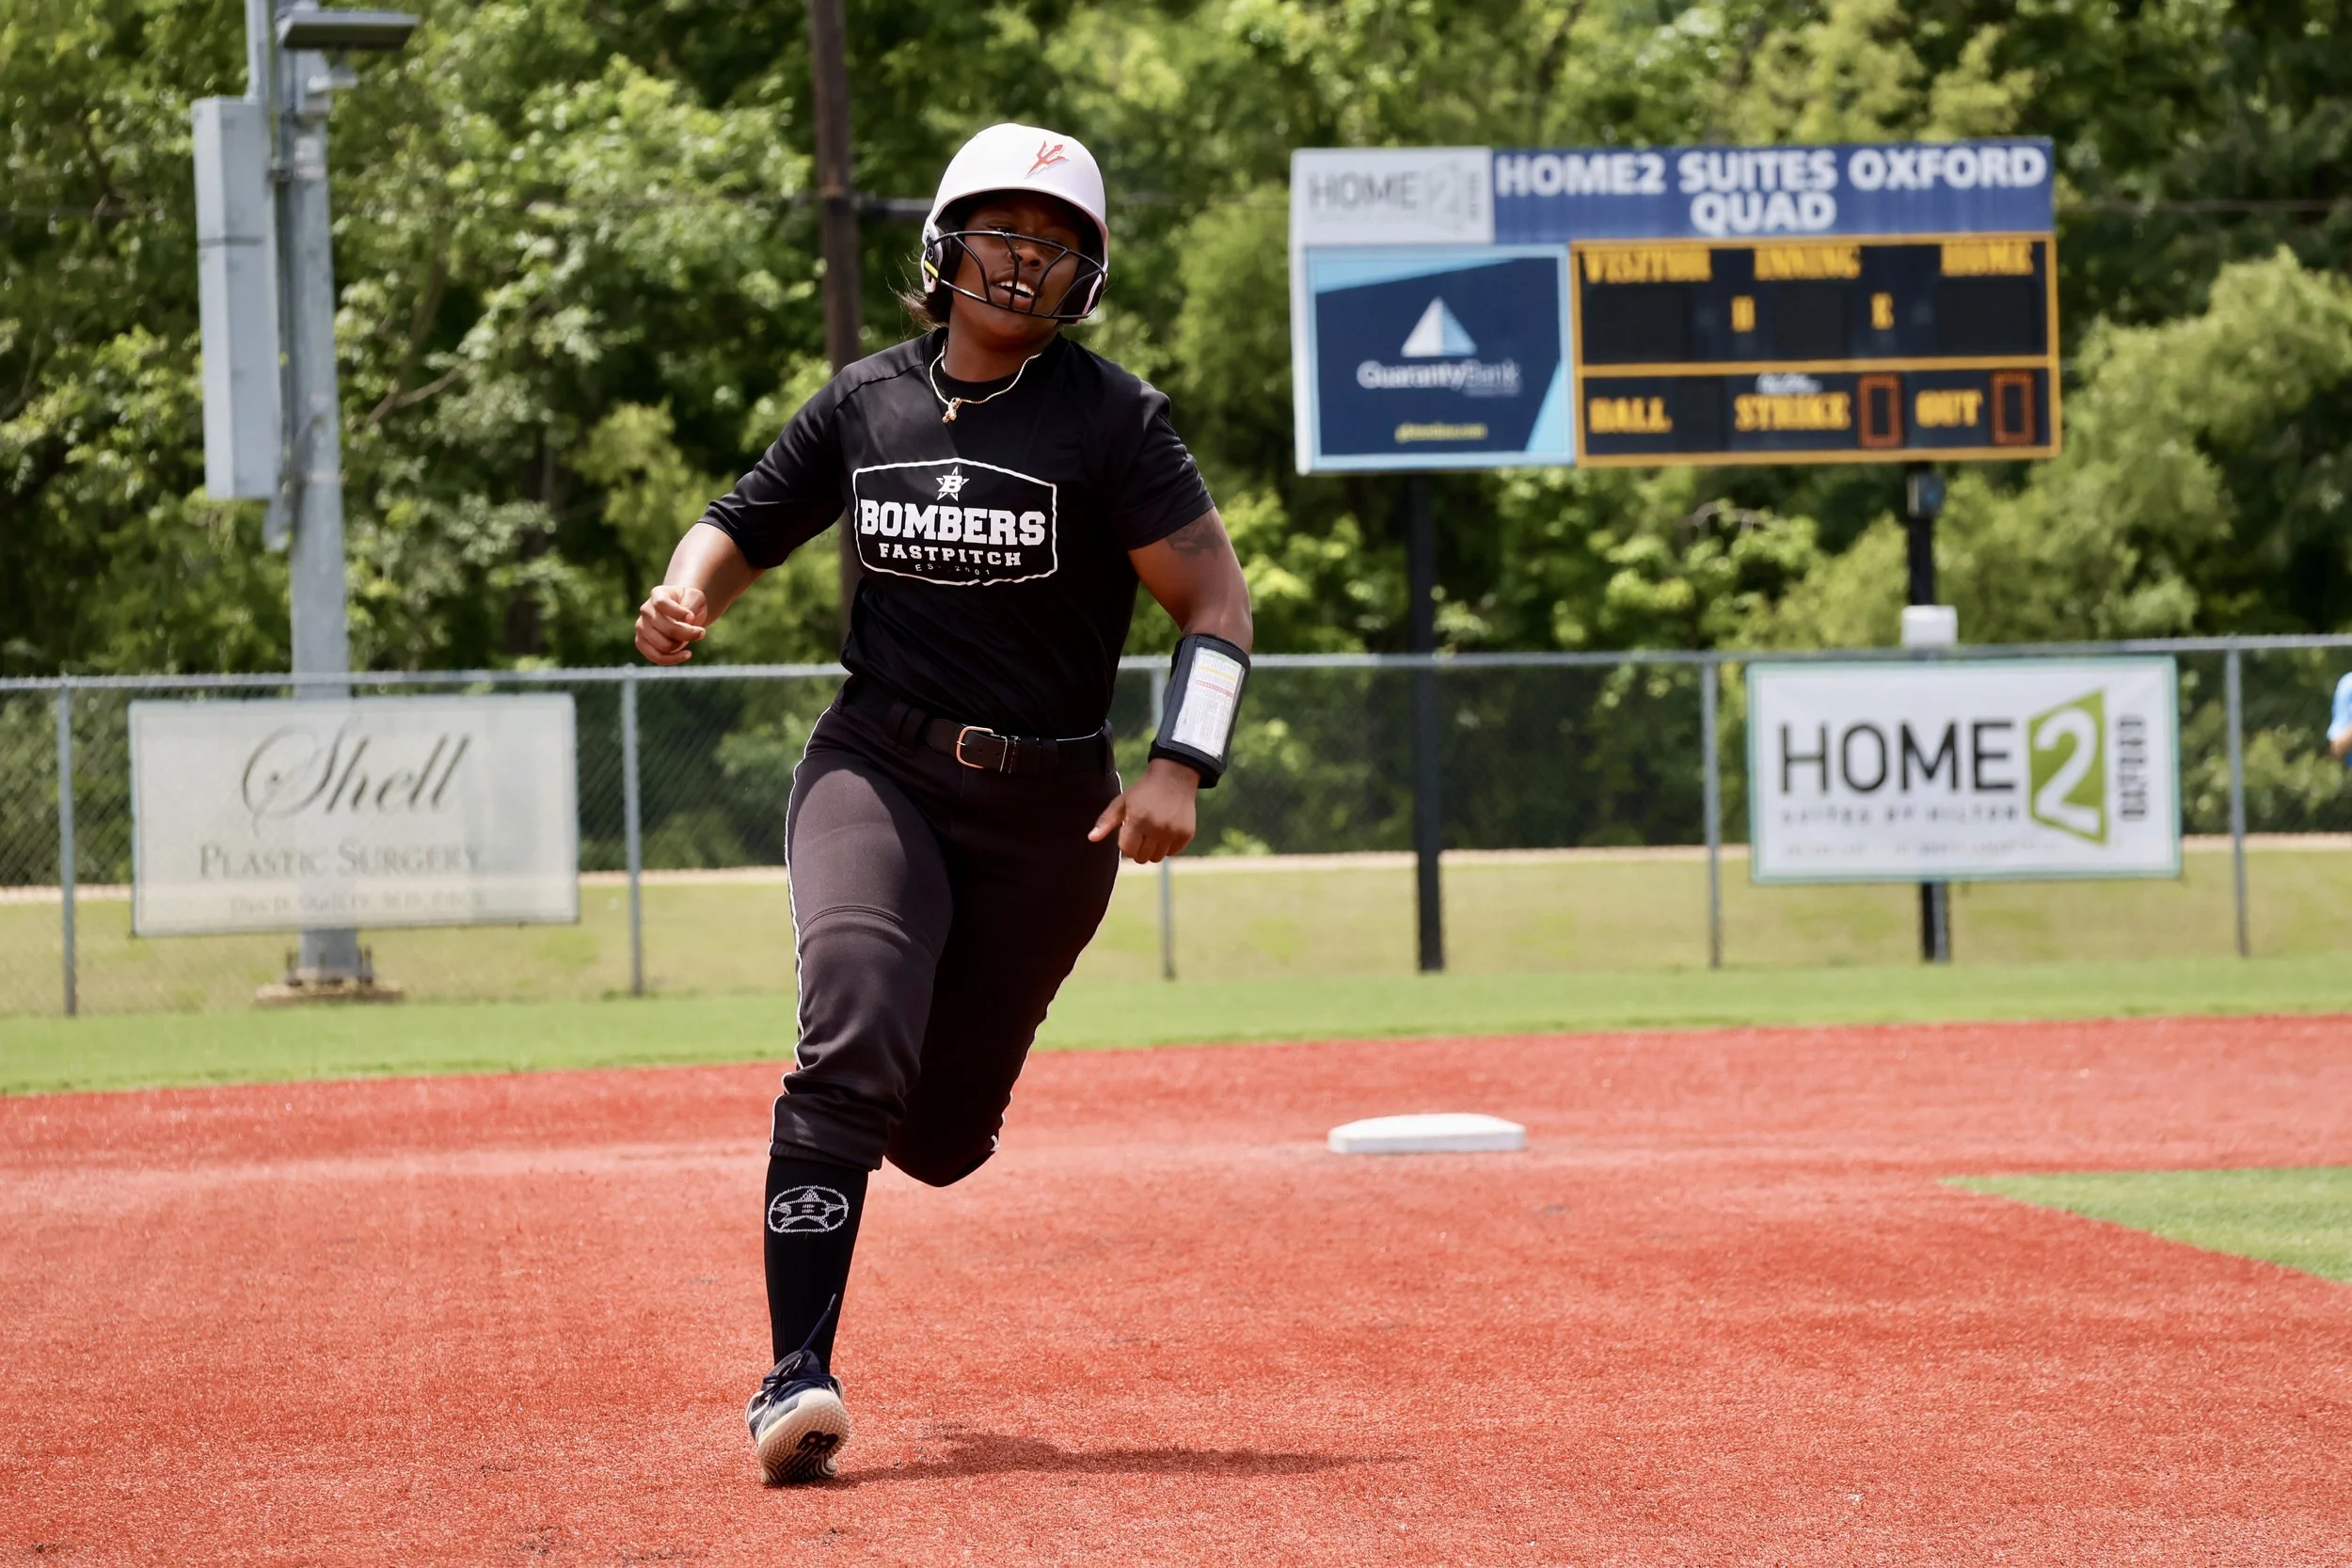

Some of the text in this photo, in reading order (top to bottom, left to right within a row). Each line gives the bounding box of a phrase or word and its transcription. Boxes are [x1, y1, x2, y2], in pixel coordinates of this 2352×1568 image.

[1308, 170, 1418, 213] HOME
[1496, 153, 1667, 197] HOME2
[1677, 150, 1839, 193] SUITES
[1848, 146, 2048, 190] OXFORD
[1690, 191, 1838, 237] QUAD
[1589, 397, 1674, 433] BALL
[1735, 392, 1851, 432] STRIKE
[1915, 388, 1983, 429] OUT
[860, 499, 1046, 546] BOMBERS
[879, 543, 1022, 567] FASTPITCH
[241, 717, 473, 839] Shell
[1778, 718, 2017, 795] HOME
[199, 835, 486, 879] PLASTIC SURGERY
